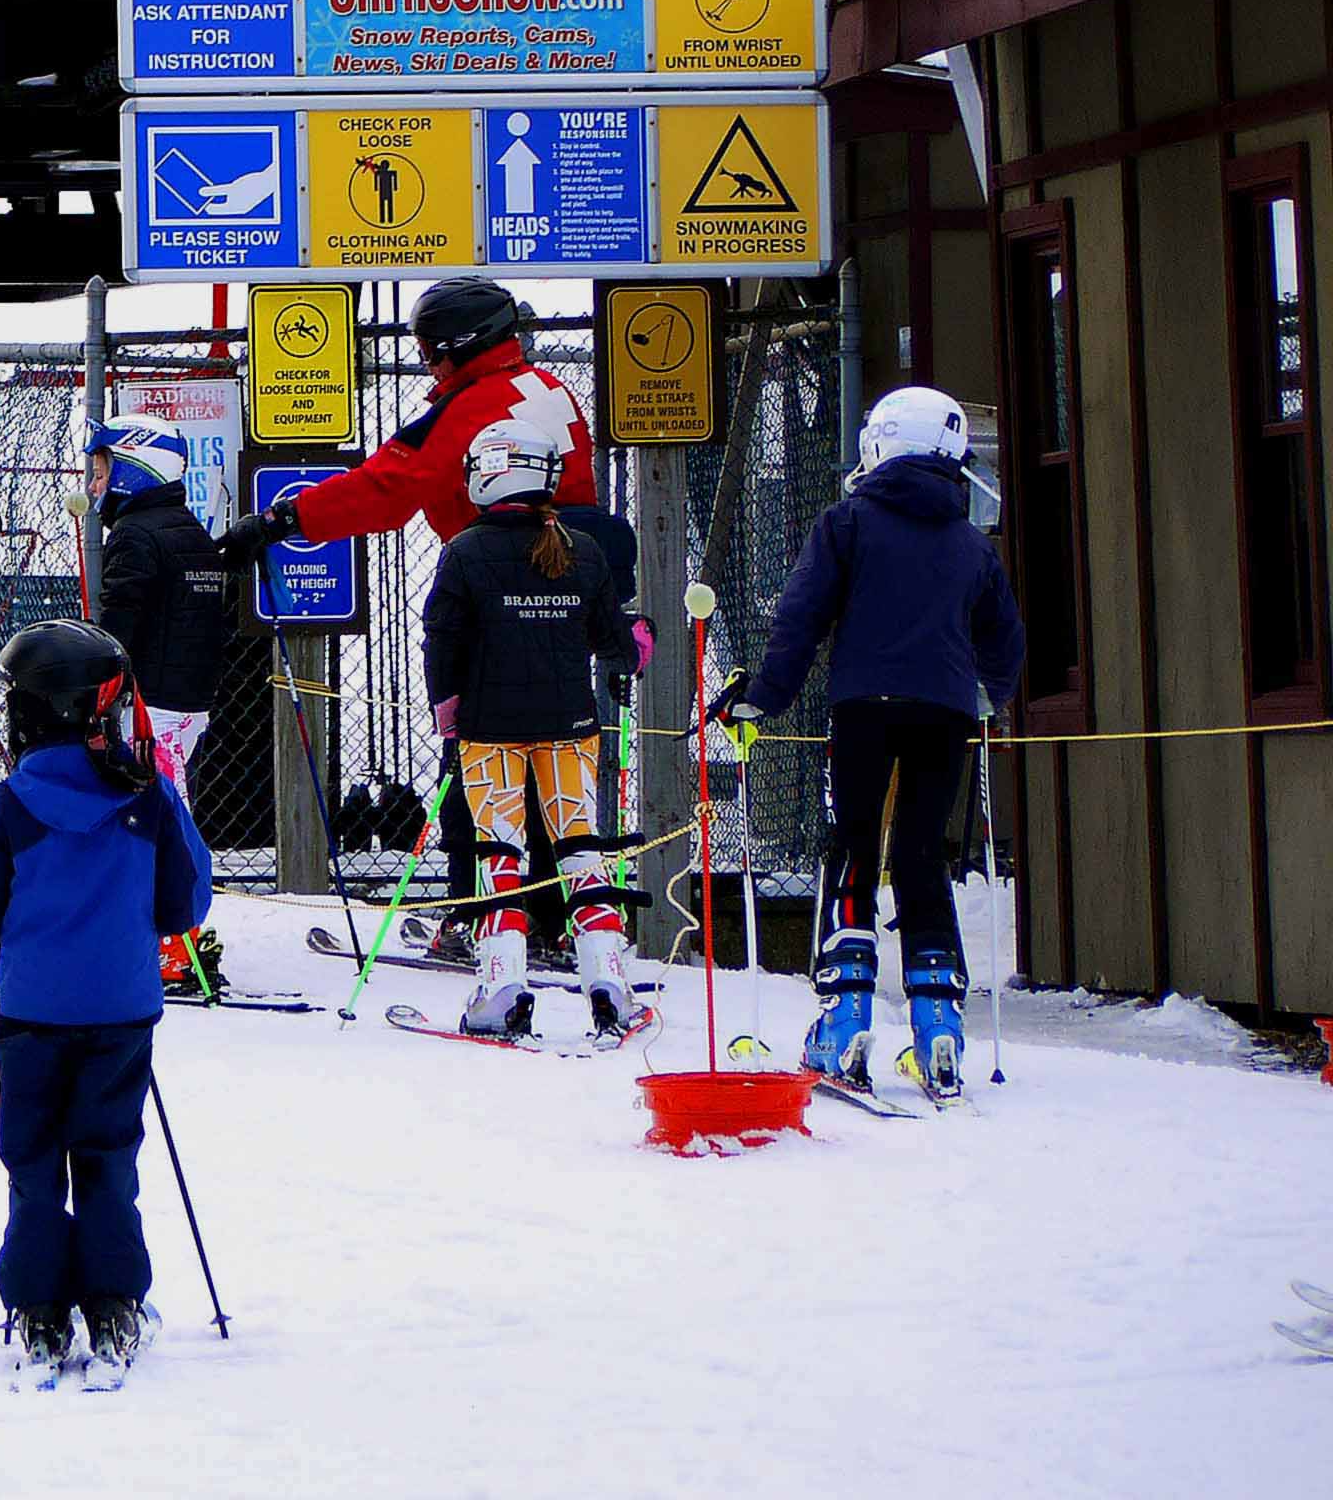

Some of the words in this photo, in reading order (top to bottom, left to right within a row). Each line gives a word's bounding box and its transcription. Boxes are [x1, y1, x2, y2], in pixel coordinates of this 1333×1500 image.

[133, 4, 173, 21] ASK
[176, 3, 289, 20] ATTENDANT
[191, 29, 230, 45] FOR
[350, 28, 413, 46] Snow
[420, 26, 517, 47] Reports,
[524, 26, 597, 47] Cams,
[684, 39, 729, 52] FROM
[733, 39, 783, 51] WRIST
[148, 53, 275, 70] INSTRUCTION
[333, 54, 403, 76] News,
[410, 52, 447, 72] Ski
[453, 52, 518, 71] Deals
[524, 52, 541, 70] &
[548, 51, 616, 71] More!
[665, 56, 711, 69] UNTIL
[715, 55, 801, 68] UNLOADED
[339, 118, 395, 131] CHECK
[399, 117, 432, 130] FOR
[559, 112, 628, 129] YOU'RE
[359, 134, 413, 147] LOOSE
[559, 129, 628, 139] RESPONSIBLE
[491, 216, 550, 237] HEADS
[676, 219, 808, 236] SNOWMAKING
[149, 231, 221, 247] PLEASE
[224, 230, 280, 246] SHOW
[327, 235, 409, 248] CLOTHING
[413, 234, 448, 247] AND
[506, 238, 537, 261] UP
[678, 239, 696, 254] IN
[702, 238, 806, 254] PROGRESS
[183, 249, 248, 265] TICKET
[341, 251, 435, 265] EQUIPMENT
[274, 370, 309, 380] CHECK
[309, 370, 331, 380] FOR
[259, 384, 292, 395] LOOSE
[293, 384, 345, 395] CLOTHING
[639, 380, 682, 390] REMOVE
[291, 399, 315, 409] AND
[627, 393, 654, 404] POLE
[655, 392, 695, 403] STRAPS
[146, 405, 171, 419] SKI
[174, 405, 215, 419] AREA
[273, 413, 334, 425] EQUIPMENT
[626, 407, 655, 418] FROM
[657, 406, 697, 417] WRISTS
[619, 420, 649, 431] UNTIL
[651, 419, 705, 430] UNLOADED
[283, 564, 328, 576] LOADING
[300, 578, 338, 589] HEIGHT
[502, 595, 581, 606] BRADFORD
[518, 609, 536, 619] SKI
[537, 609, 569, 619] TEAM
